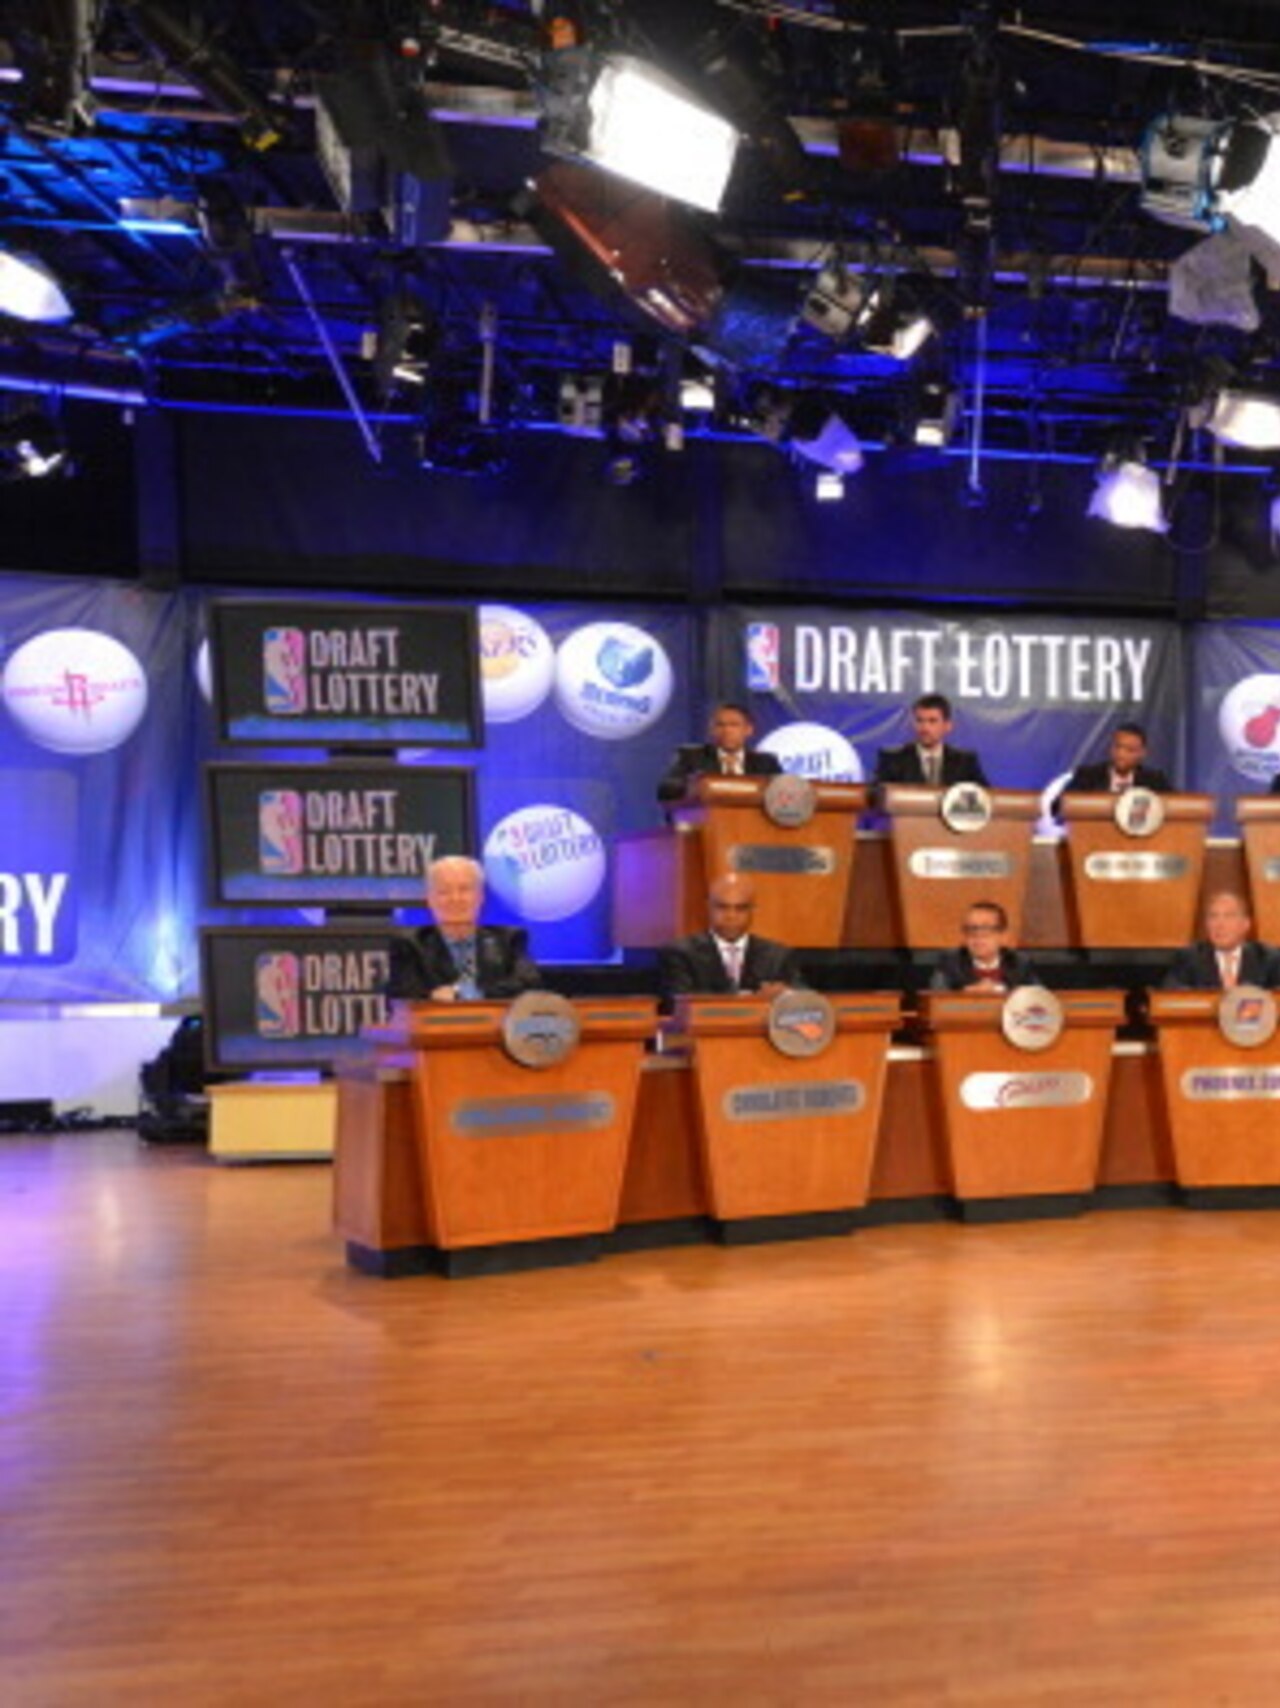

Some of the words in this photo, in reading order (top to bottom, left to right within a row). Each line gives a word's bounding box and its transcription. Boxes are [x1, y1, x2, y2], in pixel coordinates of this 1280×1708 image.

[309, 627, 398, 668] DRAFT
[795, 625, 941, 693] DRAFT
[957, 631, 1151, 701] LOTTERY
[311, 672, 439, 714] LOTTERY
[306, 790, 397, 831] DRAFT
[308, 833, 437, 874] LOTTERY
